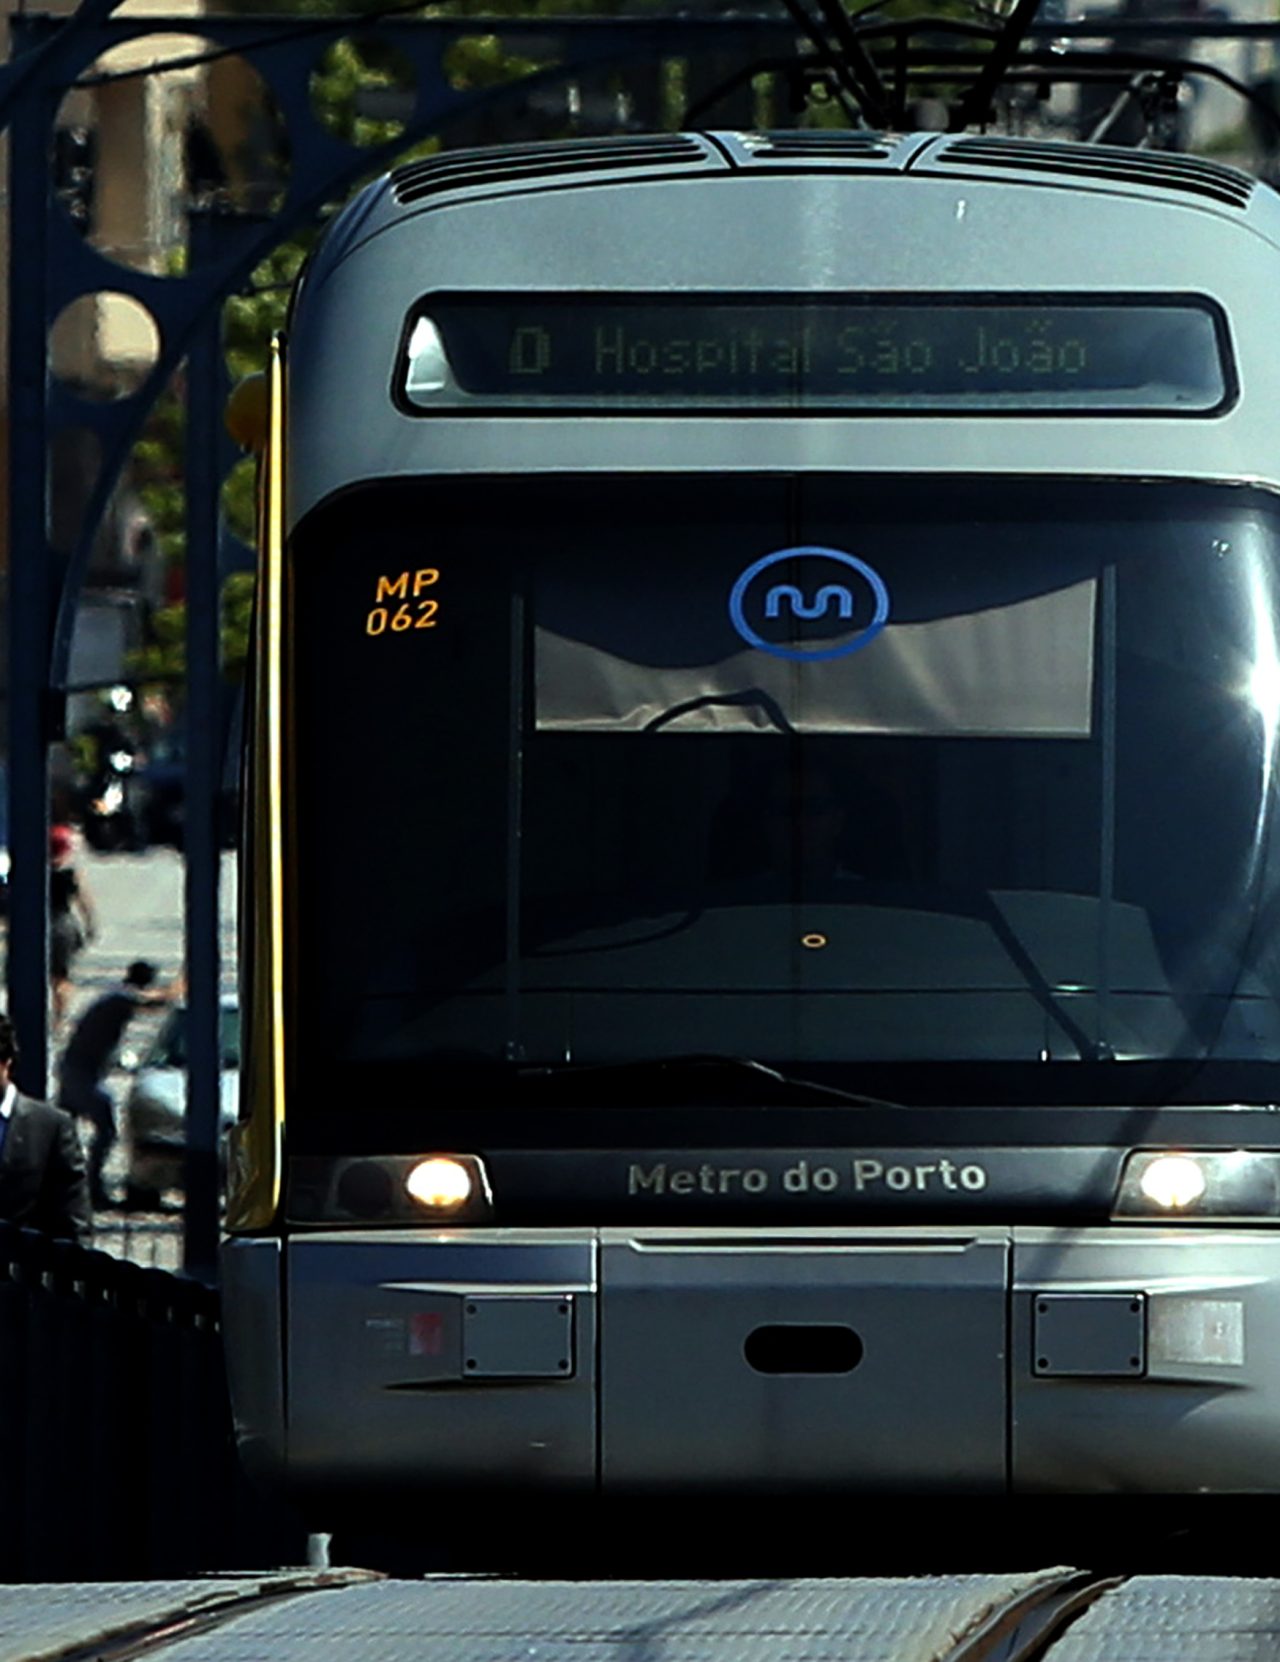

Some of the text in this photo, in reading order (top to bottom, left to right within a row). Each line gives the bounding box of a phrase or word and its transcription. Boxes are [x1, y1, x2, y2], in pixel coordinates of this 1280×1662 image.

[509, 318, 1087, 375] D Hospital São João
[376, 567, 440, 603] MP
[366, 600, 439, 636] 062
[627, 1158, 987, 1195] Metro do Porto
